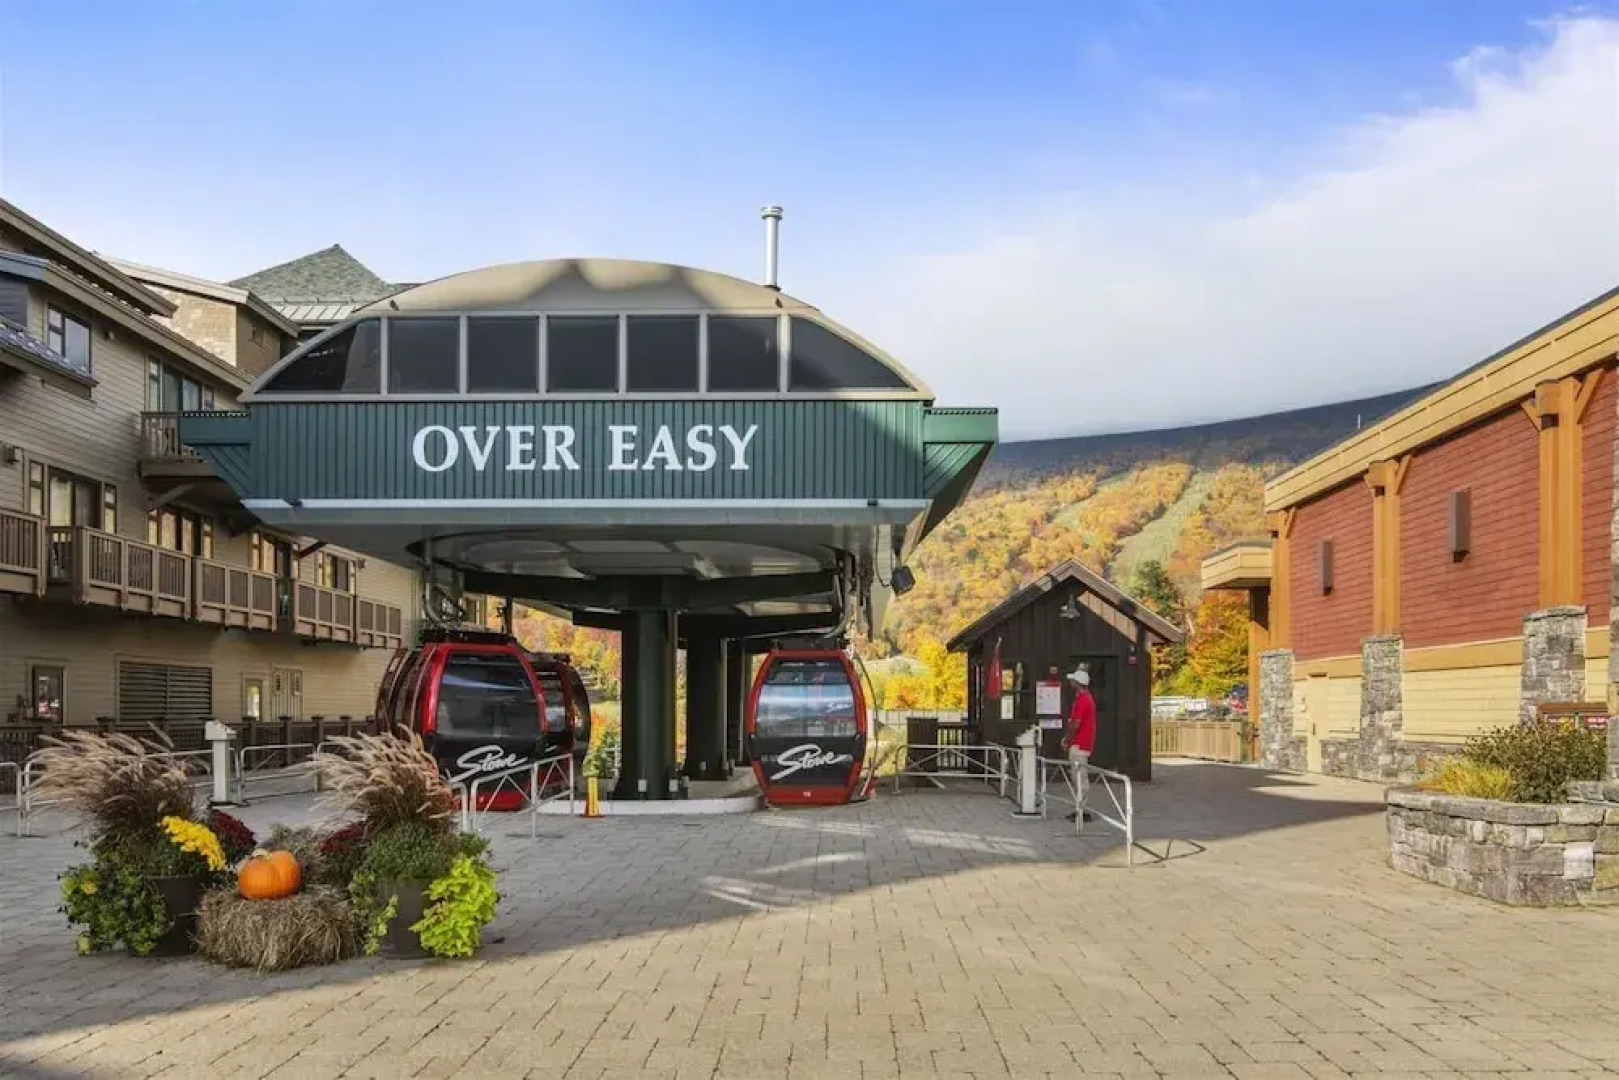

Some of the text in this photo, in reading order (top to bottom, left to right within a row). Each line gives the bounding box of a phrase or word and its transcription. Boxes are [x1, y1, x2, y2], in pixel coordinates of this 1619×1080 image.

[412, 423, 758, 472] OVER EASY
[449, 744, 528, 783] Stowe
[770, 743, 852, 780] Stowe
